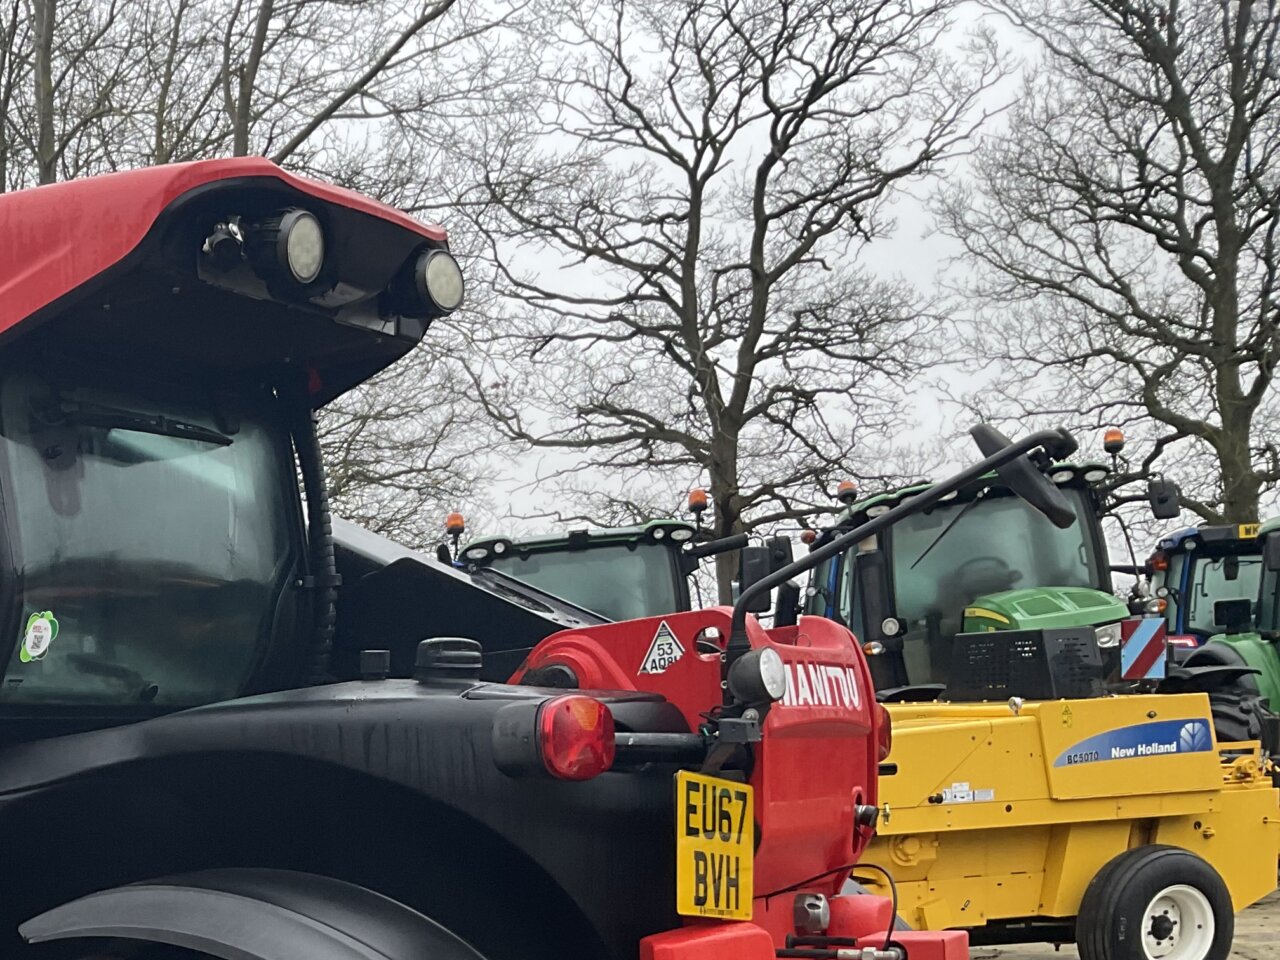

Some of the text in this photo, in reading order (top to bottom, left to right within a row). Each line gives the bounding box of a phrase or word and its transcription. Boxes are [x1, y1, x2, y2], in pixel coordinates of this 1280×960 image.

[657, 642, 674, 657] 53
[1067, 741, 1177, 765] BC5070 New Holland
[685, 780, 748, 845] EU67
[693, 850, 740, 910] BVH
